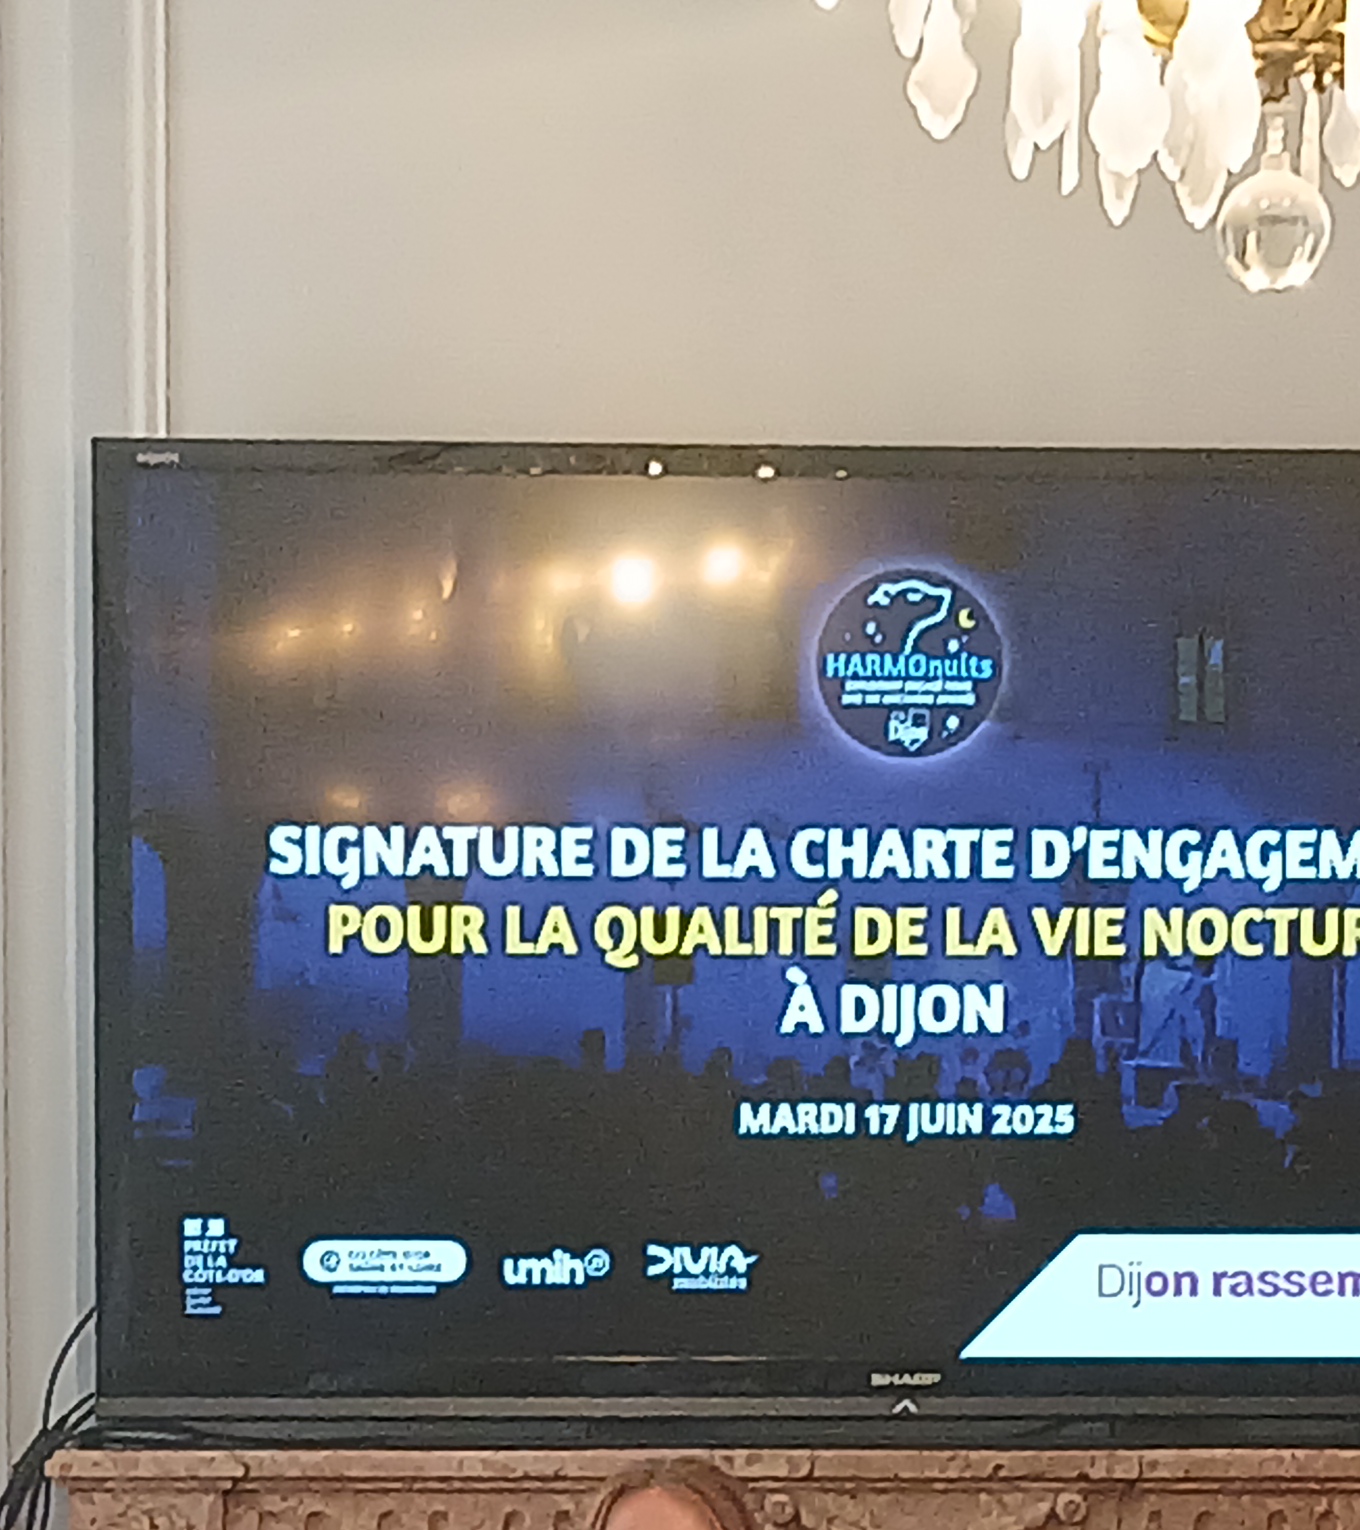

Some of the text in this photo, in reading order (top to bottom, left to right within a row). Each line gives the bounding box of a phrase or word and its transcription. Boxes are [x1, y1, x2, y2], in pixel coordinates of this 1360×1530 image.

[826, 652, 993, 678] HARMOnuits
[268, 824, 594, 888] SIGNATURE
[610, 828, 685, 877] DE
[701, 828, 775, 878] LA
[790, 829, 1015, 879] CHARTE
[329, 905, 488, 954] POUR
[505, 906, 578, 954] LA
[593, 888, 837, 967] QUALITÉ
[853, 906, 928, 955] DE
[945, 907, 1017, 956] LA
[1031, 907, 1126, 956] VIE
[779, 967, 1005, 1047] À DIJON
[739, 1103, 1075, 1142] MARDI 17 JUIN 2025
[503, 1249, 584, 1285] umih
[1098, 1260, 1198, 1308] Dijon
